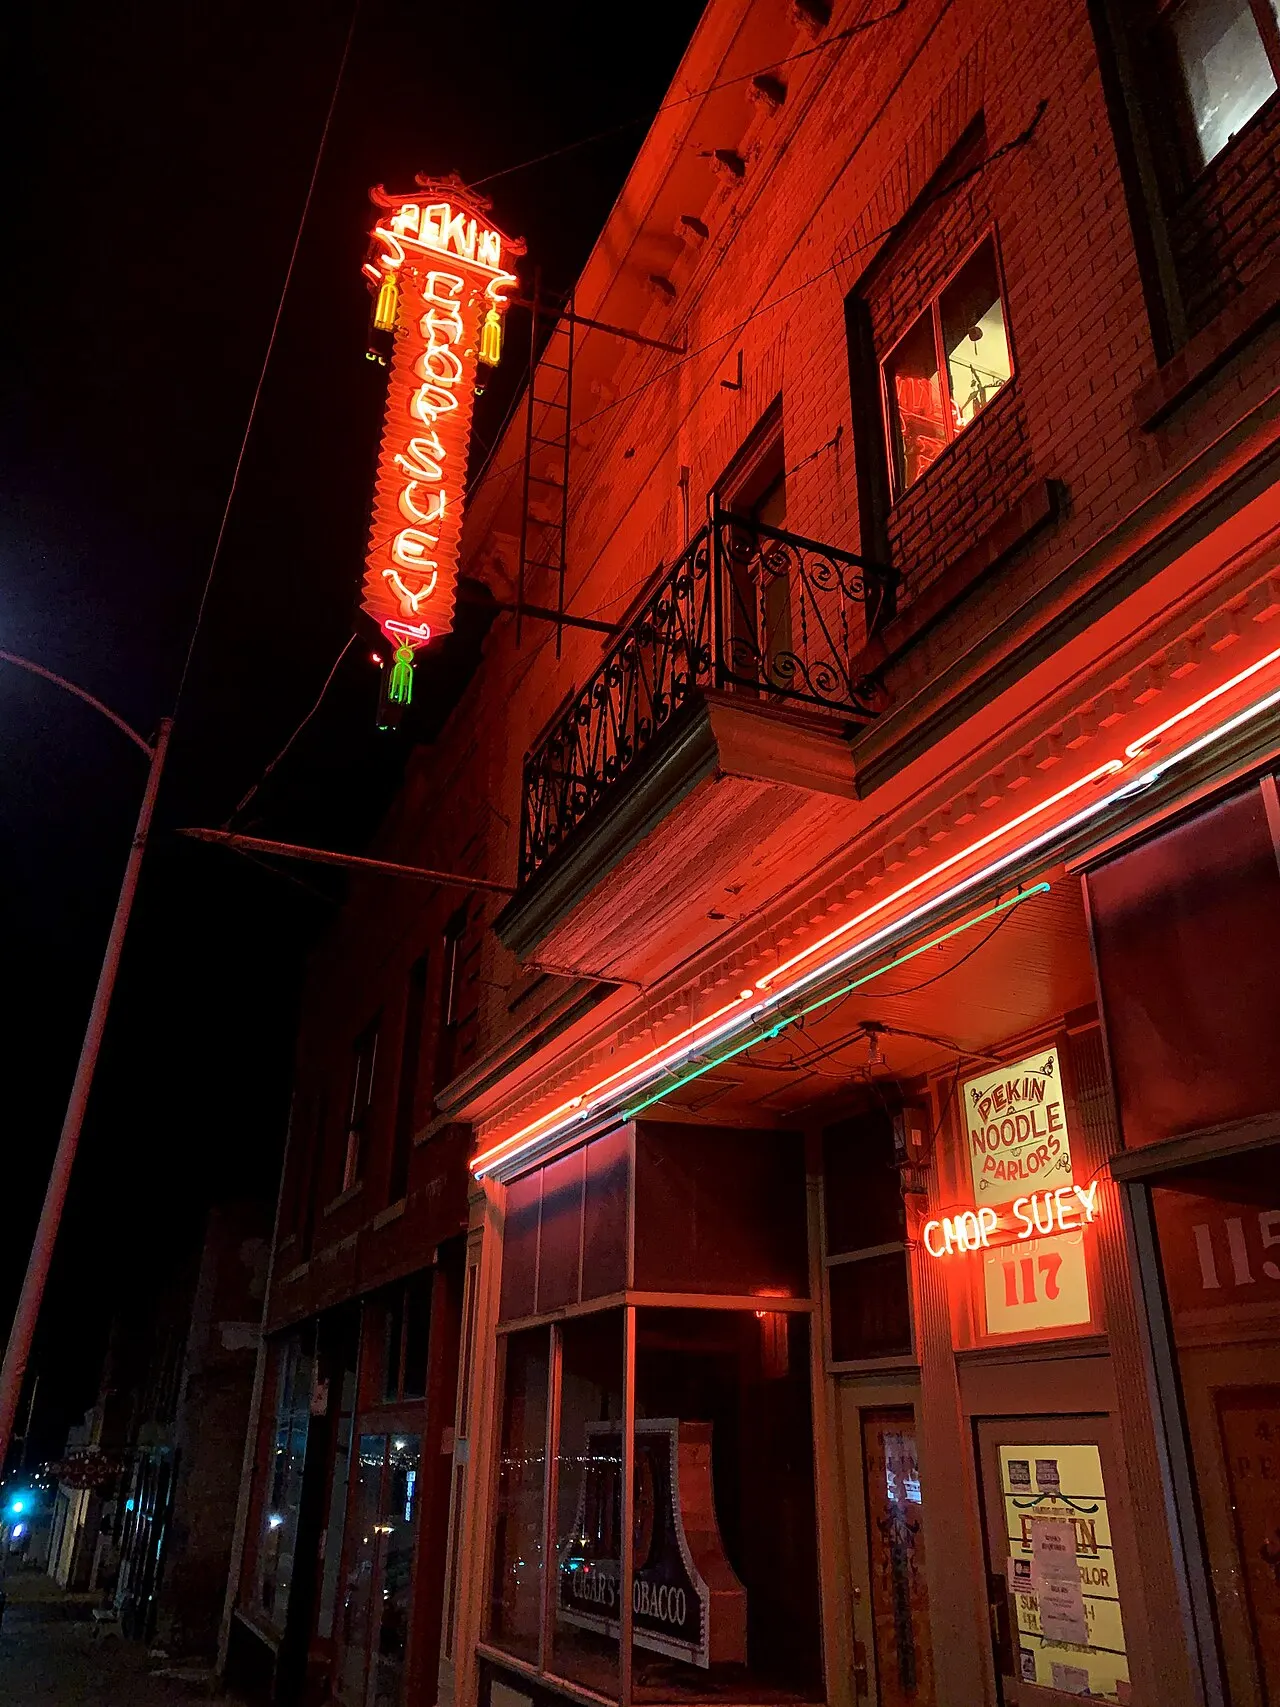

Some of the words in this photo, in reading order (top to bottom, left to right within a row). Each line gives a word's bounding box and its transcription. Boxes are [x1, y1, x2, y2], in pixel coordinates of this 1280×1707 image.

[391, 203, 501, 268] PEKIN
[411, 270, 464, 426] CHOP
[382, 437, 446, 616] SUEY
[971, 1101, 1064, 1156] NOODLE
[977, 1077, 1046, 1123] PEKIN
[981, 1134, 1061, 1182] PARLORS
[923, 1207, 997, 1258] CHOP
[1013, 1181, 1098, 1239] SUEY
[1192, 1209, 1280, 1289] 115
[1002, 1252, 1063, 1307] 117
[573, 1567, 615, 1606] CIGARS
[633, 1580, 686, 1626] OBACCO
